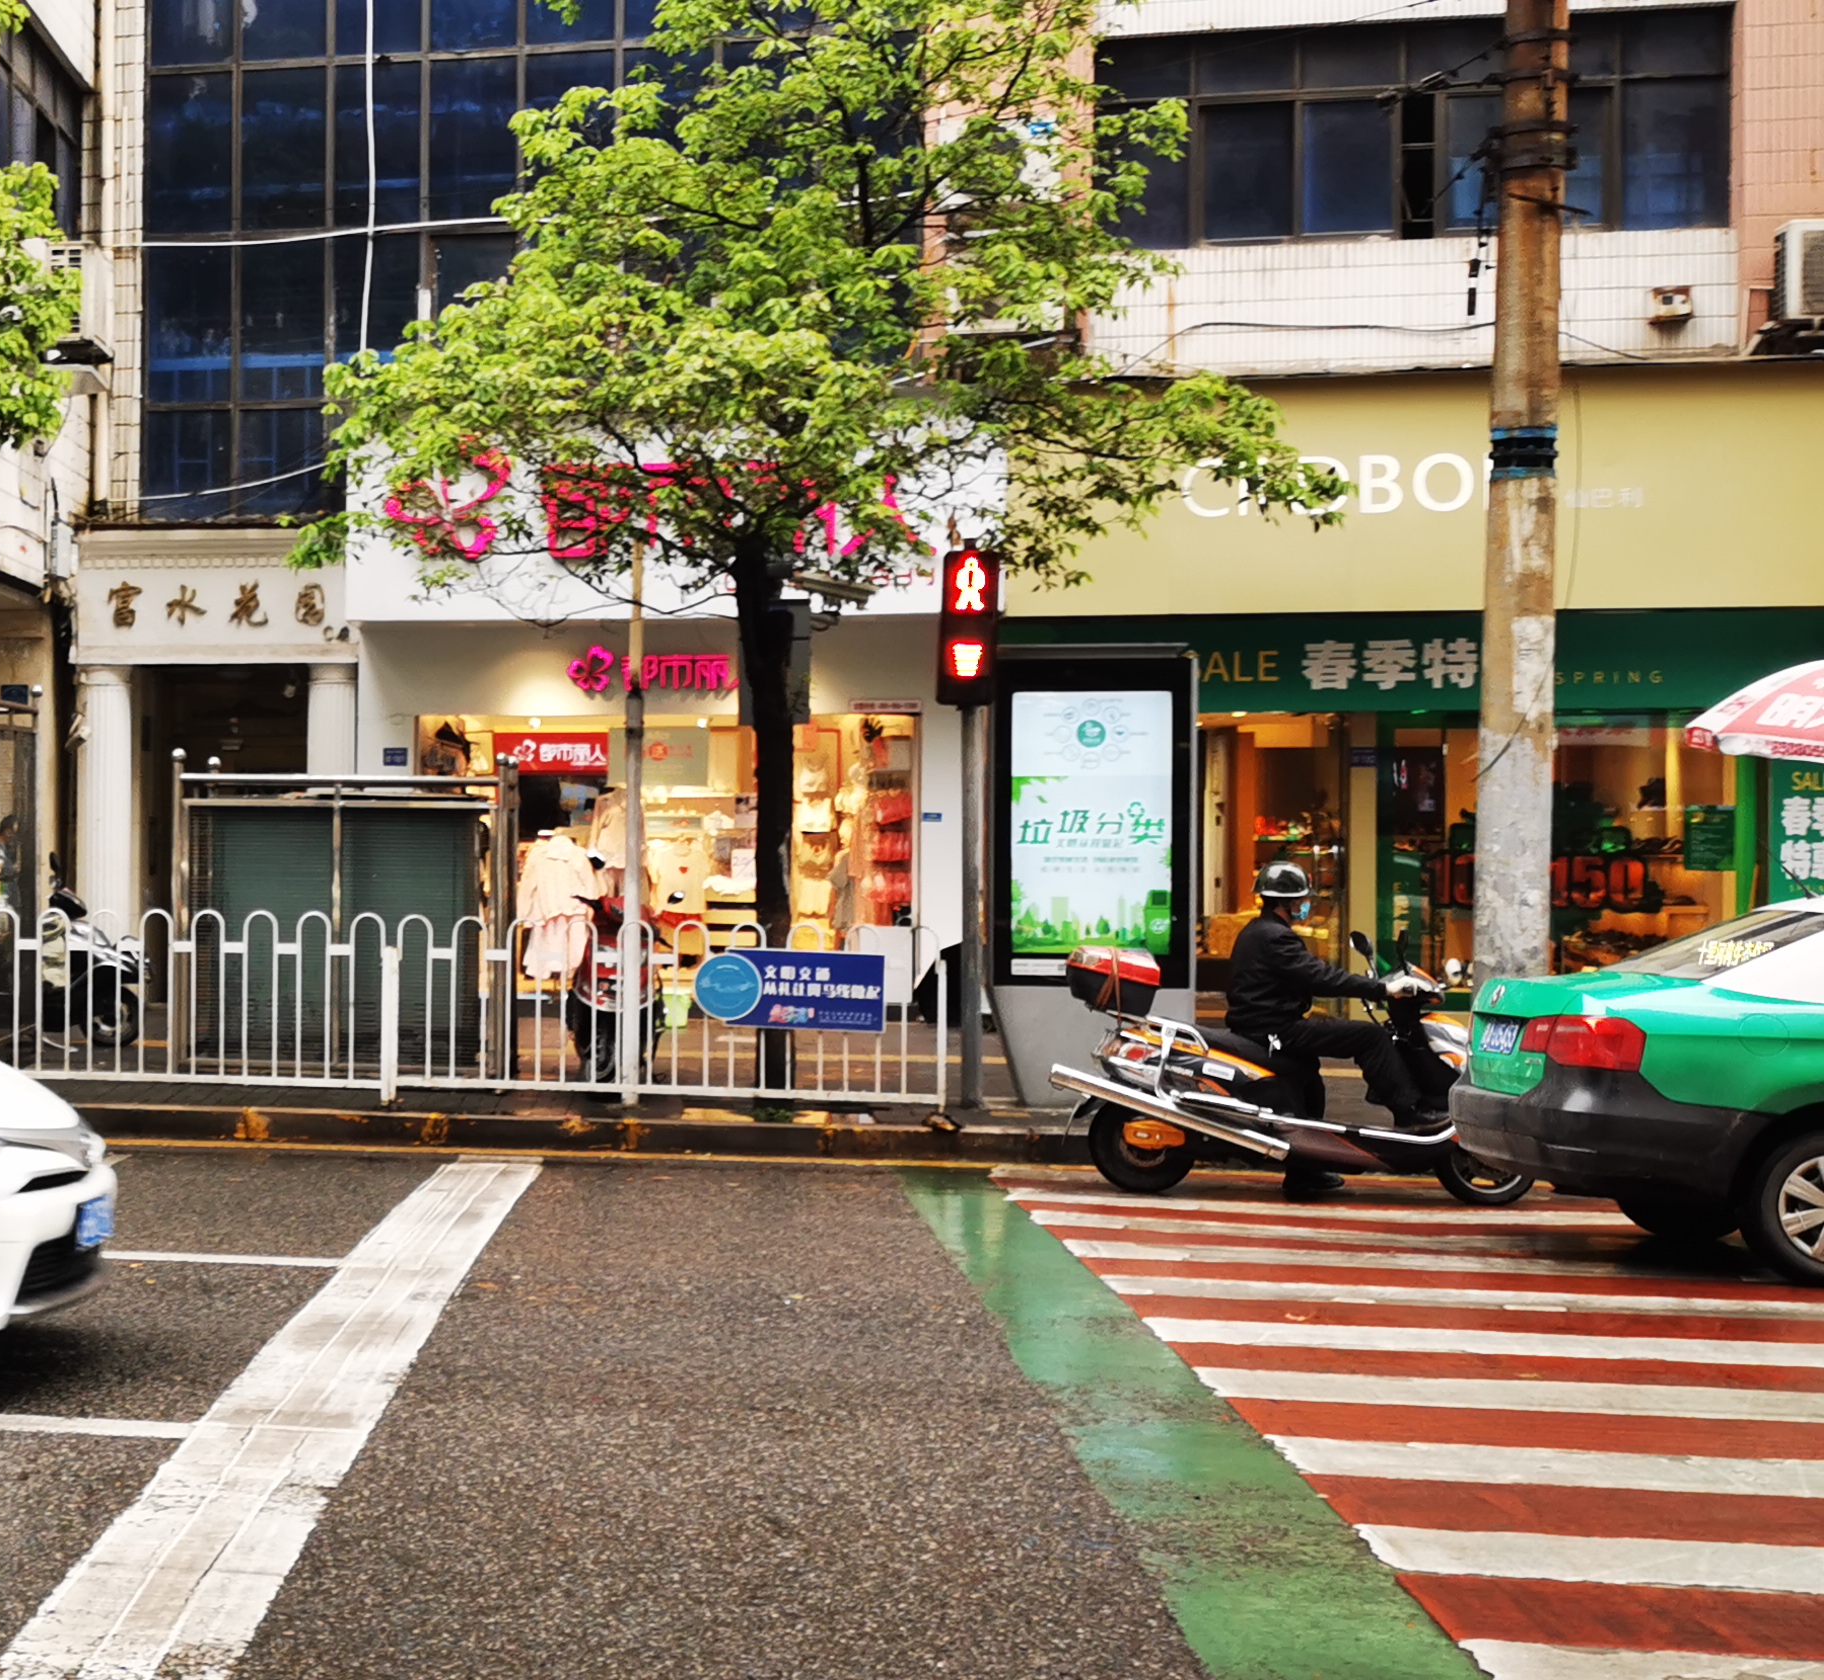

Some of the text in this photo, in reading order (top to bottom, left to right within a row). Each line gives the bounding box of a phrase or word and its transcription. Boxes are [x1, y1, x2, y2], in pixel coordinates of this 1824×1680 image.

[621, 654, 740, 691] 都市丽
[1198, 649, 1280, 683] ALE
[1554, 669, 1663, 685] SPRING
[539, 743, 608, 766] 都市丽人
[1016, 801, 1166, 845] 垃圾分类
